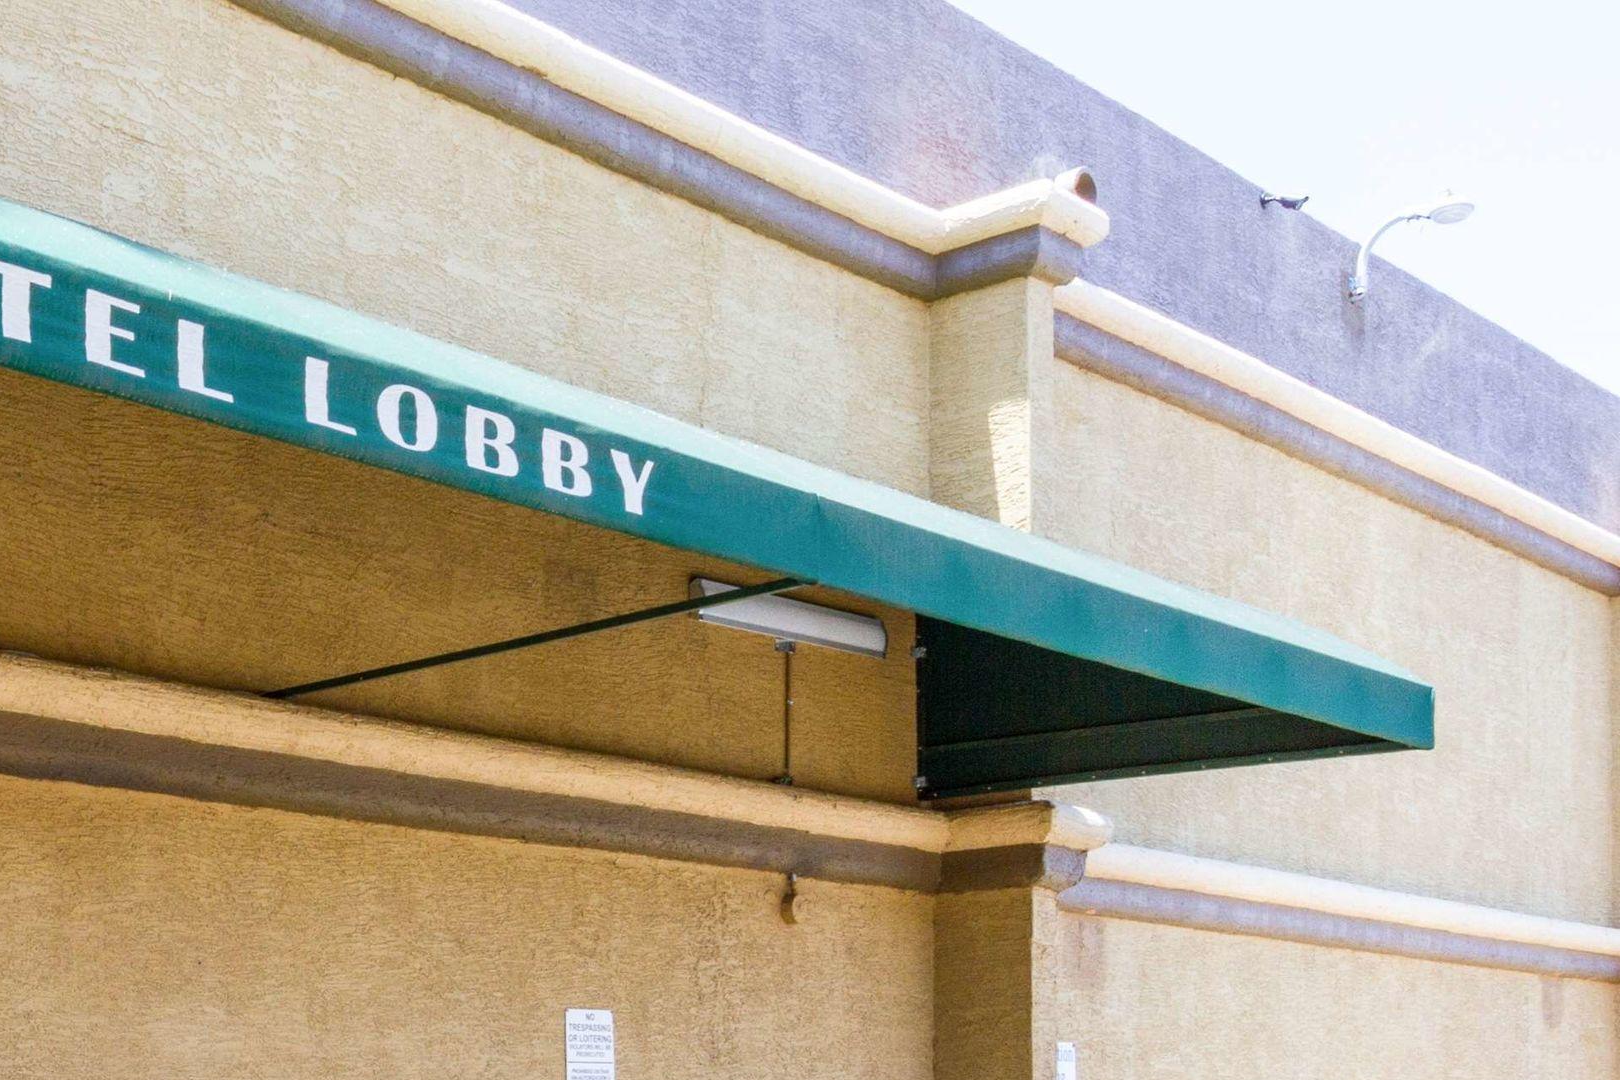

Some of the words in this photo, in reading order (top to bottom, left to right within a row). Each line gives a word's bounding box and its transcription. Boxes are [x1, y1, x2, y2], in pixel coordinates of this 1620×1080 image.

[303, 355, 655, 517] LOBBY
[585, 1012, 596, 1021] NO
[568, 1023, 612, 1033] TRESPASSING
[568, 1034, 578, 1042] OR
[579, 1034, 612, 1044] LOITERING
